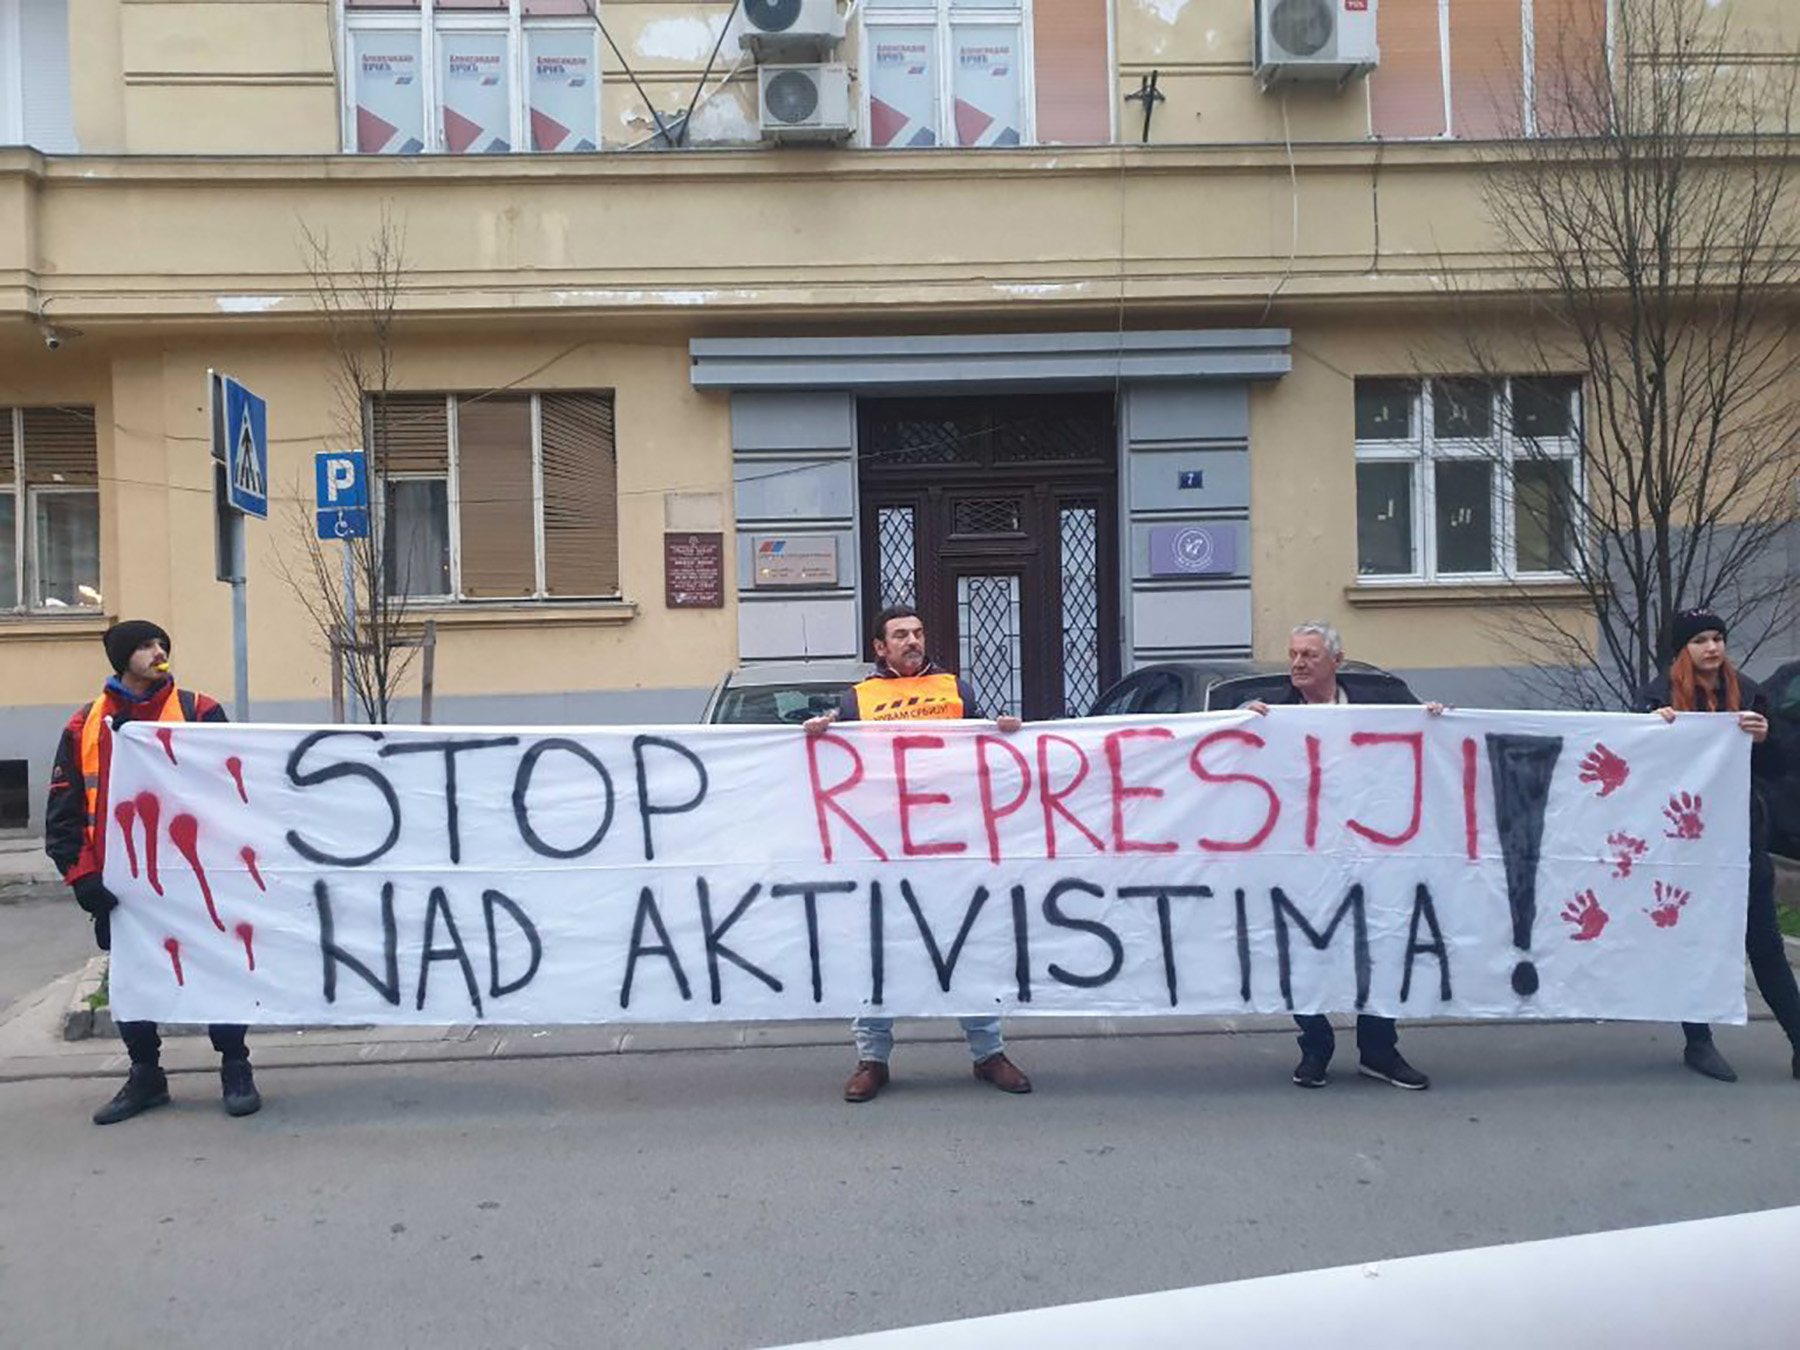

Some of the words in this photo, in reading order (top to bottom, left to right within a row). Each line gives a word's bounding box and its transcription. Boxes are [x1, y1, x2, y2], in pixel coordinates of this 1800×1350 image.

[327, 459, 355, 502] P
[1187, 473, 1194, 486] 7
[286, 731, 708, 867] STOP
[805, 728, 1479, 863] REPRESIJI
[314, 880, 541, 1018] NAD
